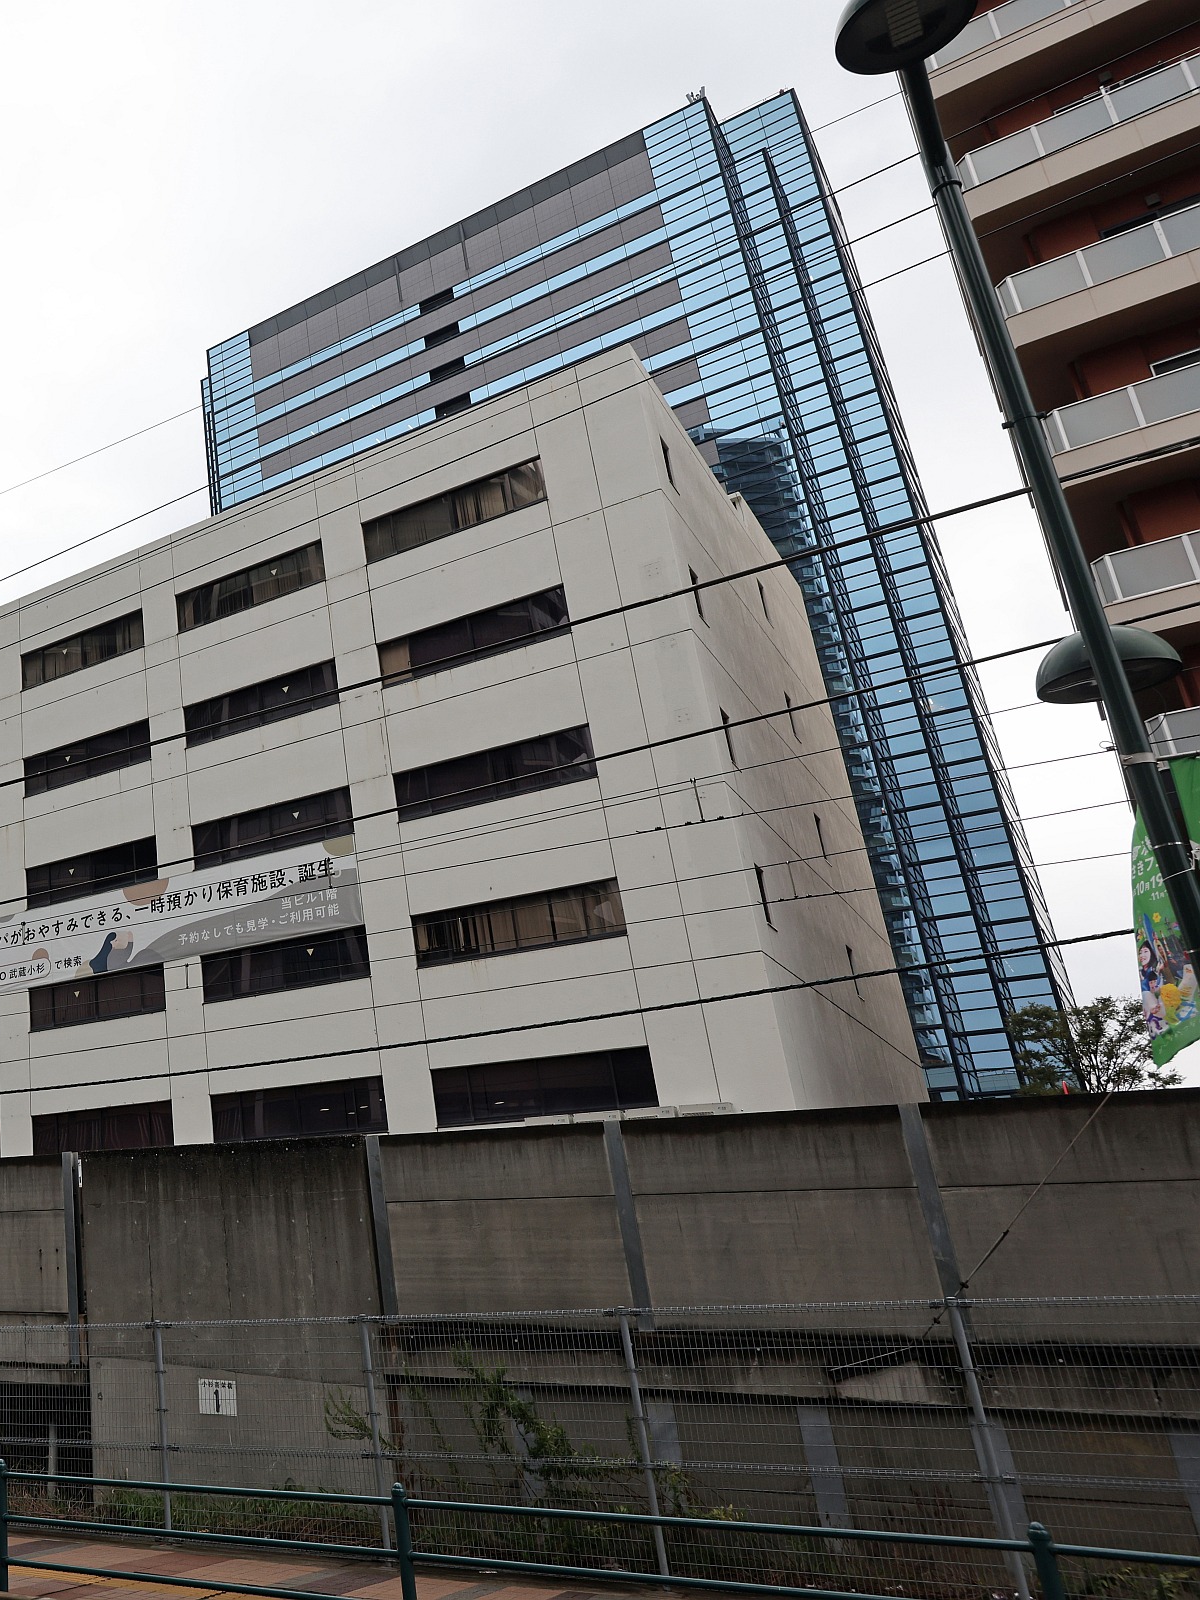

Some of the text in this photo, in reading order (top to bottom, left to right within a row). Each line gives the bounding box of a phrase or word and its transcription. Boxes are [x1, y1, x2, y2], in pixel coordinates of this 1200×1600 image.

[281, 887, 338, 910] 当ビル1階
[178, 903, 340, 946] 予約なしでも見学・ご利用可能
[9, 962, 46, 979] 武蔵小杉
[54, 955, 82, 970] で検索
[213, 1389, 221, 1413] 1
